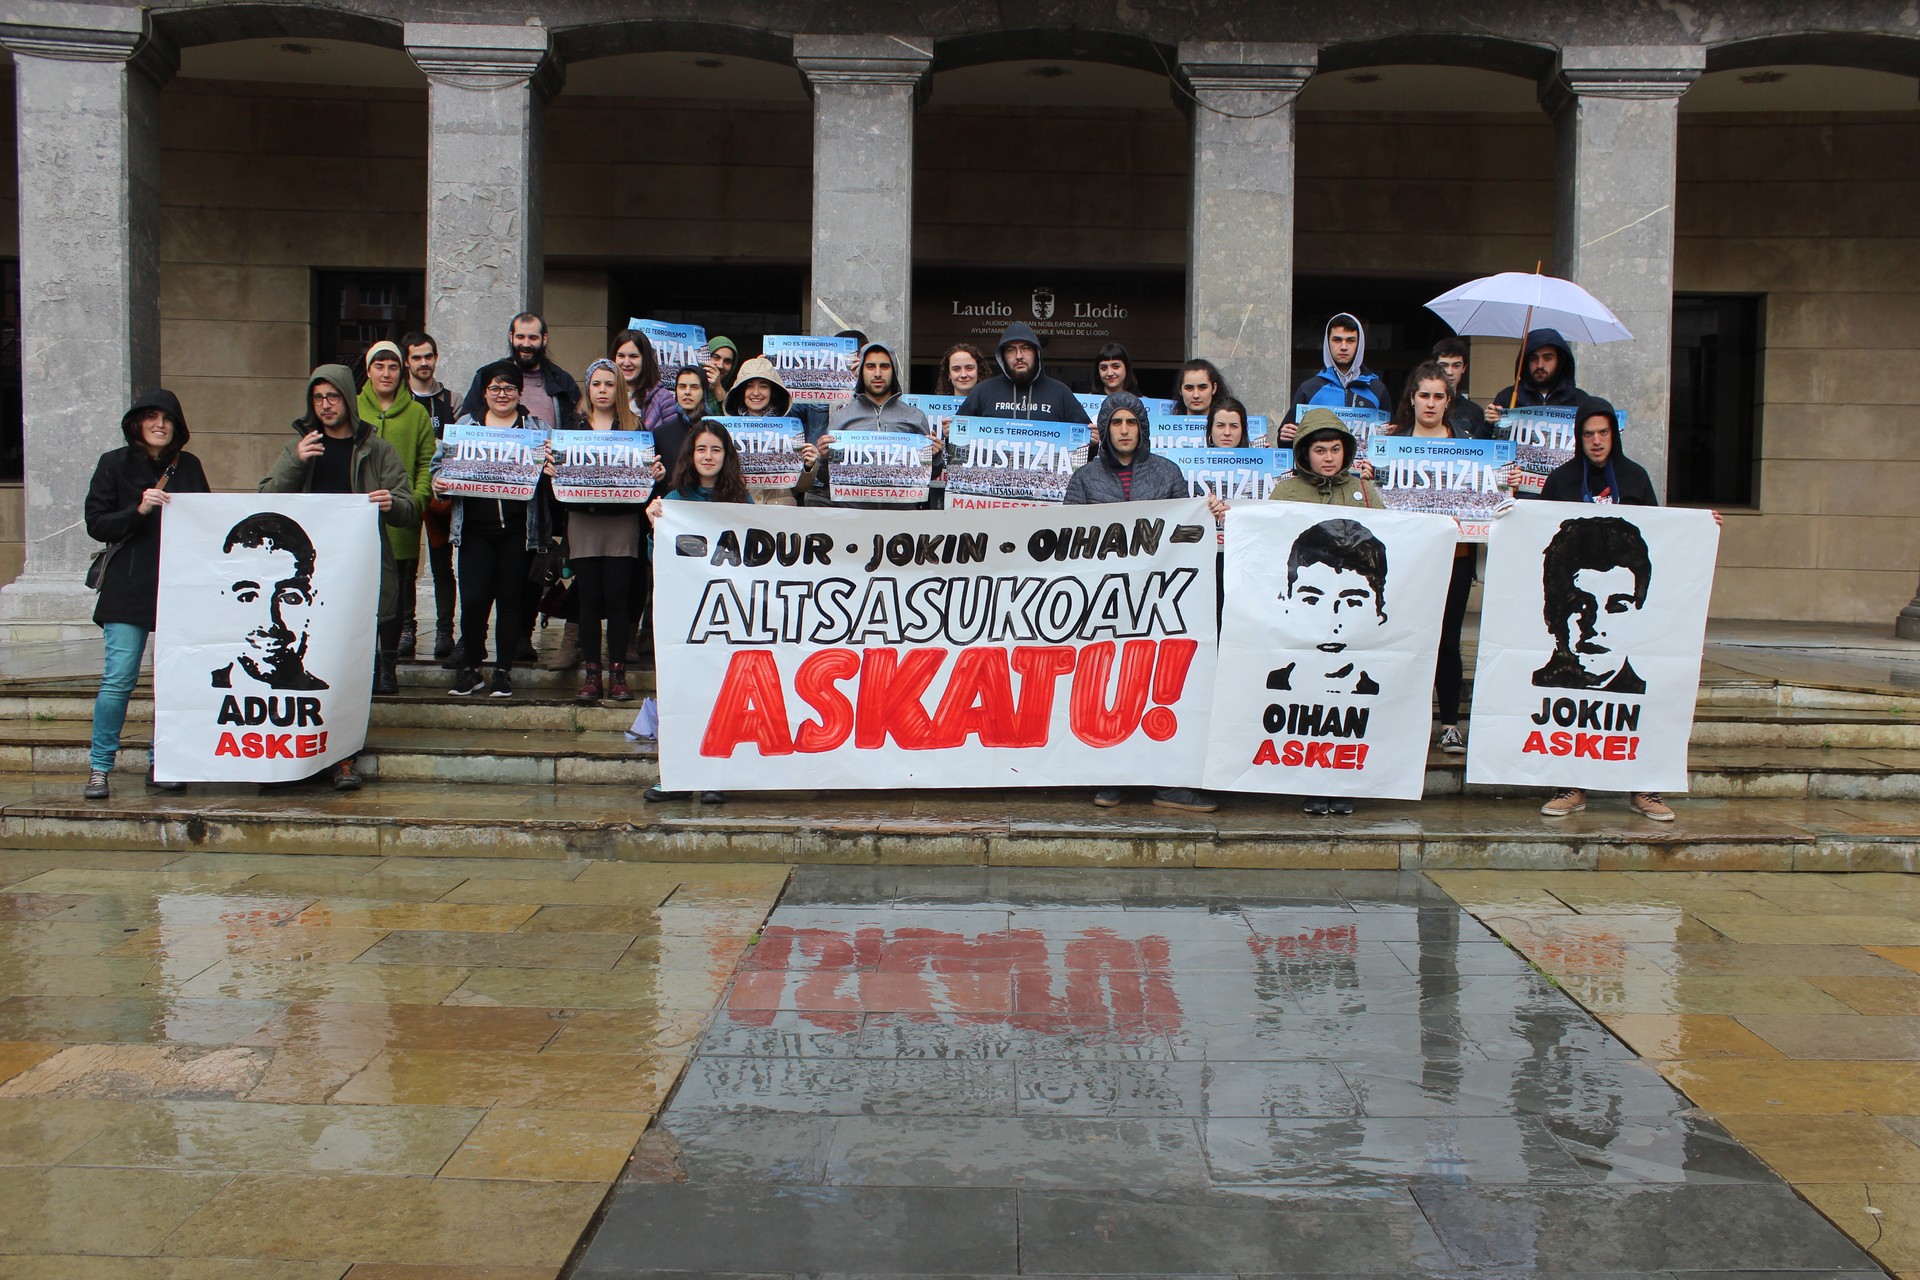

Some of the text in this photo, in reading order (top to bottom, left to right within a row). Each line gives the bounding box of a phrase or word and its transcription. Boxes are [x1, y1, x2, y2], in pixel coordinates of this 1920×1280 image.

[952, 300, 1013, 317] Laudio
[1073, 303, 1128, 319] Llodio
[652, 328, 687, 339] TERRORISMO
[650, 339, 699, 367] TIZIA
[773, 349, 848, 372] JUSTIZIA
[790, 391, 850, 400] IFESTAZIOA
[1041, 403, 1052, 413] EZ
[486, 432, 525, 440] TERRORISMO
[957, 424, 967, 433] 14
[979, 426, 991, 434] NO
[1006, 428, 1061, 438] TERRORISMO
[1509, 418, 1576, 451] JUSTIZ
[453, 439, 534, 466] JUSTIZIA
[562, 444, 644, 468] JUSTIZIA
[840, 443, 921, 468] JUSTIZIA
[962, 438, 1073, 475] JUSTIZIA
[1375, 445, 1386, 453] 14
[1415, 446, 1425, 454] ES
[1427, 447, 1484, 456] TERRORISMO
[1179, 457, 1264, 465] NO ES TERRORISMO
[744, 475, 798, 485] ESTAZIOA
[1382, 458, 1499, 494] JUSTIZIA
[445, 482, 533, 495] MANIFESTAZIOA
[557, 489, 648, 498] MANIFESTAZIOA
[834, 488, 924, 498] MANIFESTAZIOA
[989, 487, 1034, 497] ALTSASUKOAK
[710, 526, 834, 566] ADUR
[864, 532, 989, 573] JOKIN
[1027, 518, 1167, 563] OIHAN
[687, 567, 1199, 645] ALTSASUKOAK
[699, 638, 1199, 759] ASKATU!
[217, 695, 324, 727] ADUR
[1263, 703, 1370, 738] OIHAN
[1531, 697, 1641, 731] JOKIN
[214, 731, 328, 759] ASKE!
[1252, 739, 1370, 770] ASKE!
[1522, 731, 1640, 761] ASKE!
